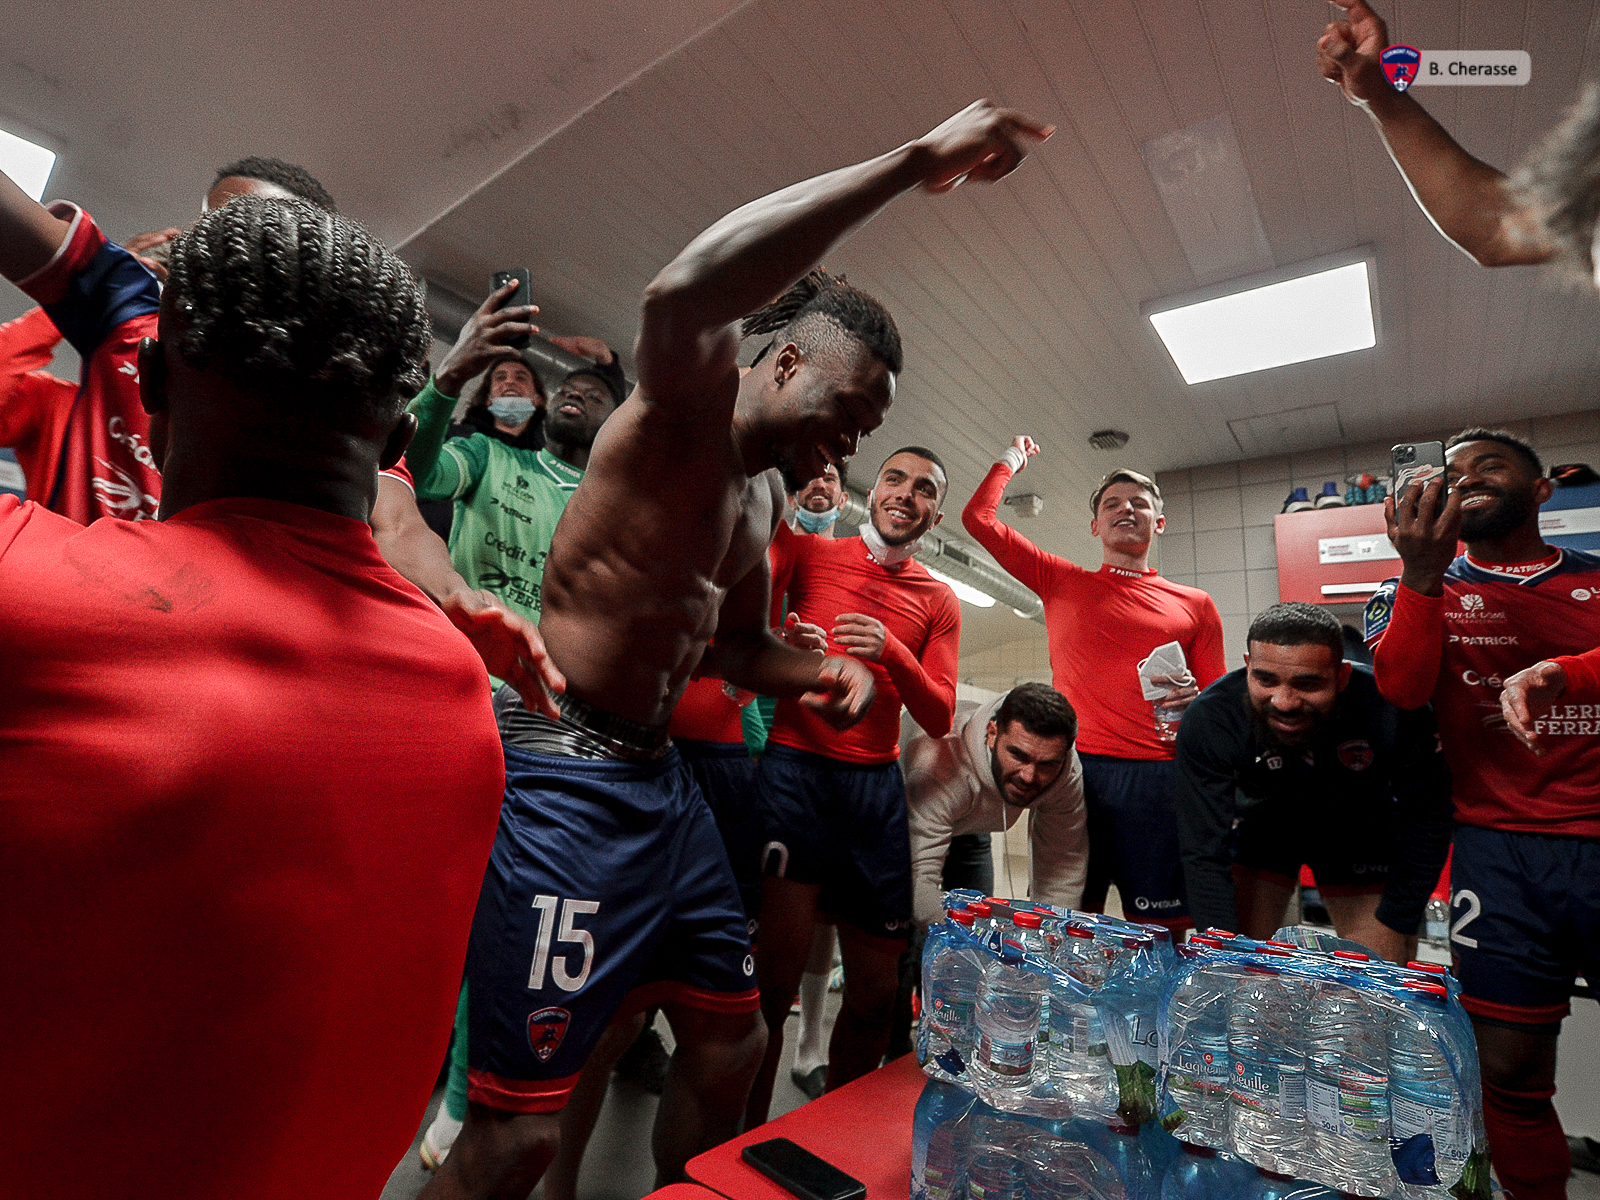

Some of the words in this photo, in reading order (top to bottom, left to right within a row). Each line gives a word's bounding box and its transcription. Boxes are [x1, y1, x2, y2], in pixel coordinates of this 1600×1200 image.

[500, 502, 532, 525] PATRICK
[484, 531, 527, 563] Crédit
[1462, 635, 1519, 646] PATRICK
[1450, 889, 1482, 949] 2
[527, 894, 601, 992] 15
